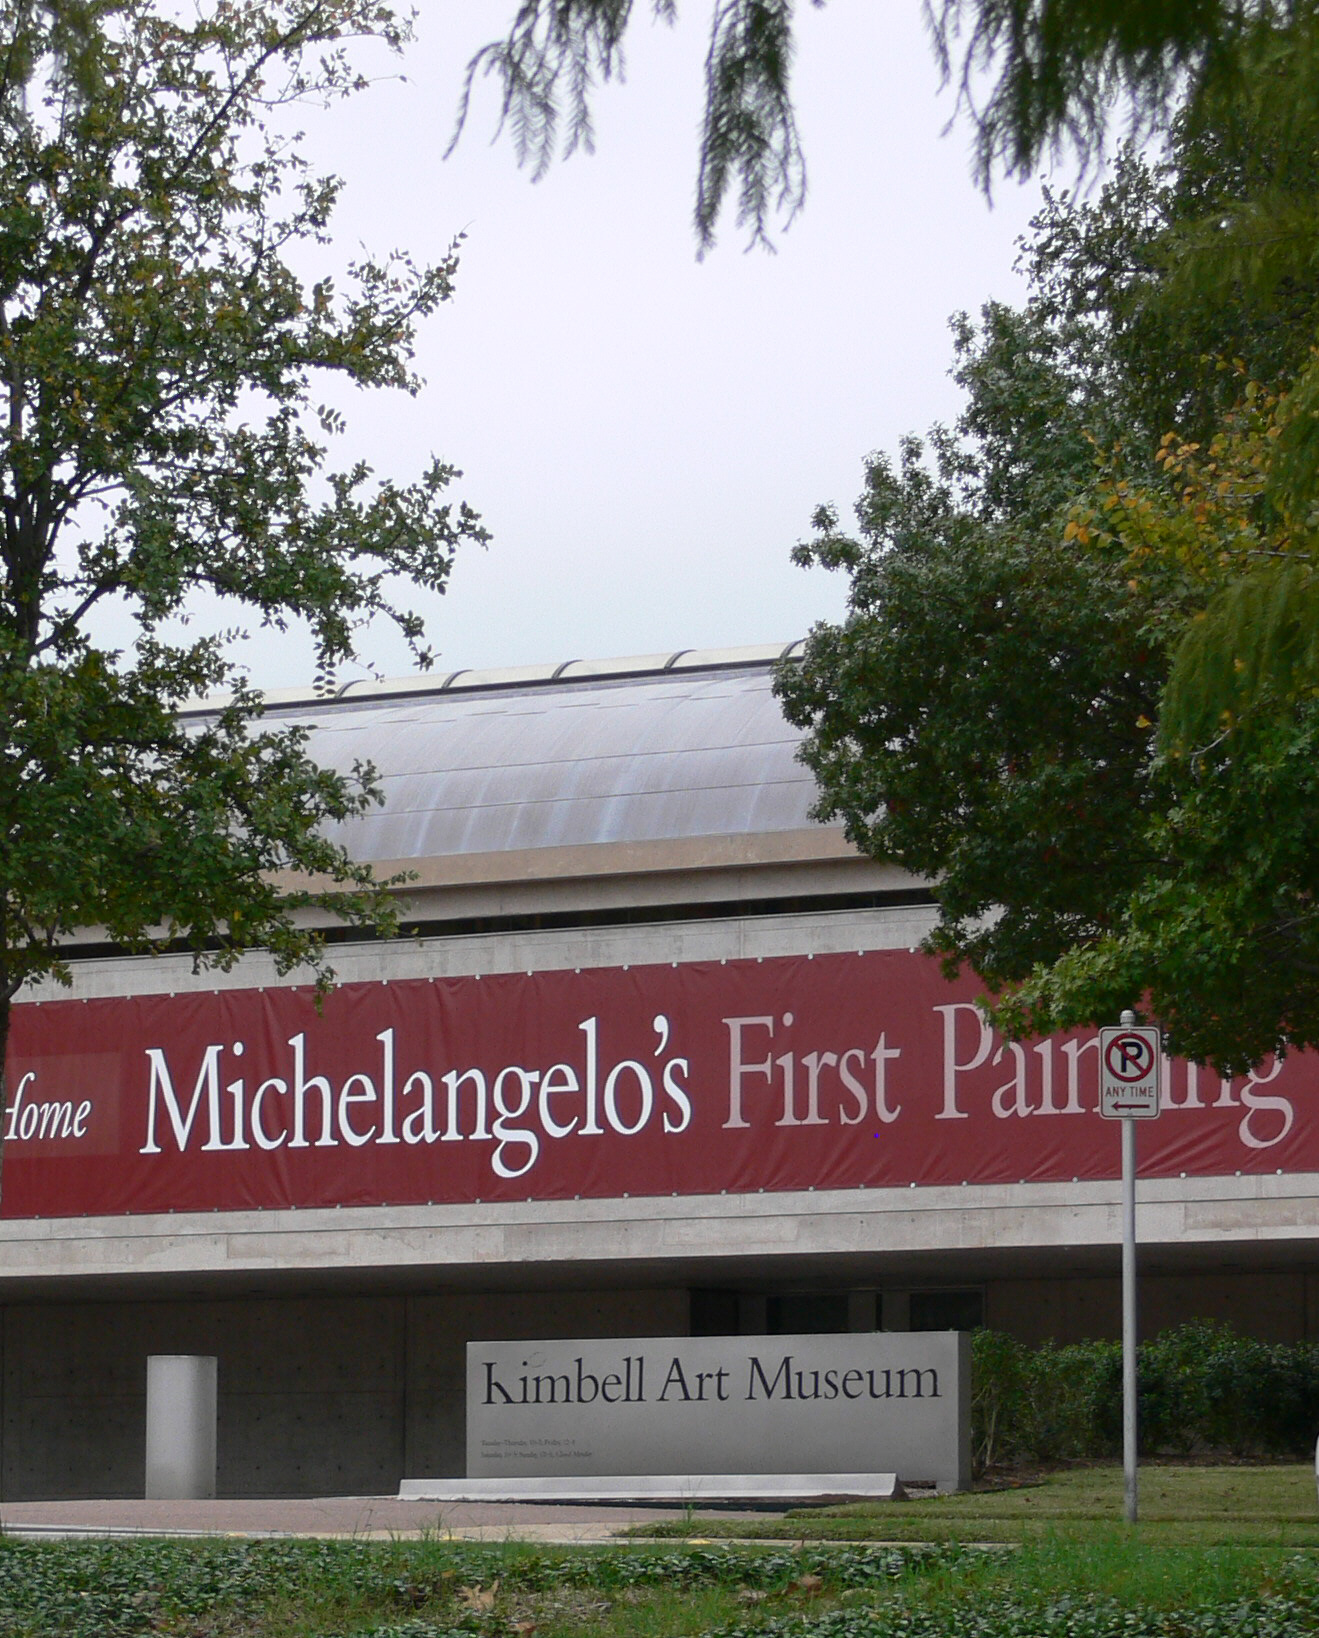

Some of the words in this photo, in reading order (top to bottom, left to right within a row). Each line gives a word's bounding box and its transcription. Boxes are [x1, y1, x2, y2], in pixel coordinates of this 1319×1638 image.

[139, 1014, 692, 1178] Michelangelo's
[722, 1012, 902, 1129] First
[1105, 1086, 1127, 1097] ANY
[1129, 1086, 1154, 1097] TIME
[481, 1356, 647, 1405] Kimbell
[657, 1356, 730, 1402] Art
[744, 1355, 943, 1401] Museum
